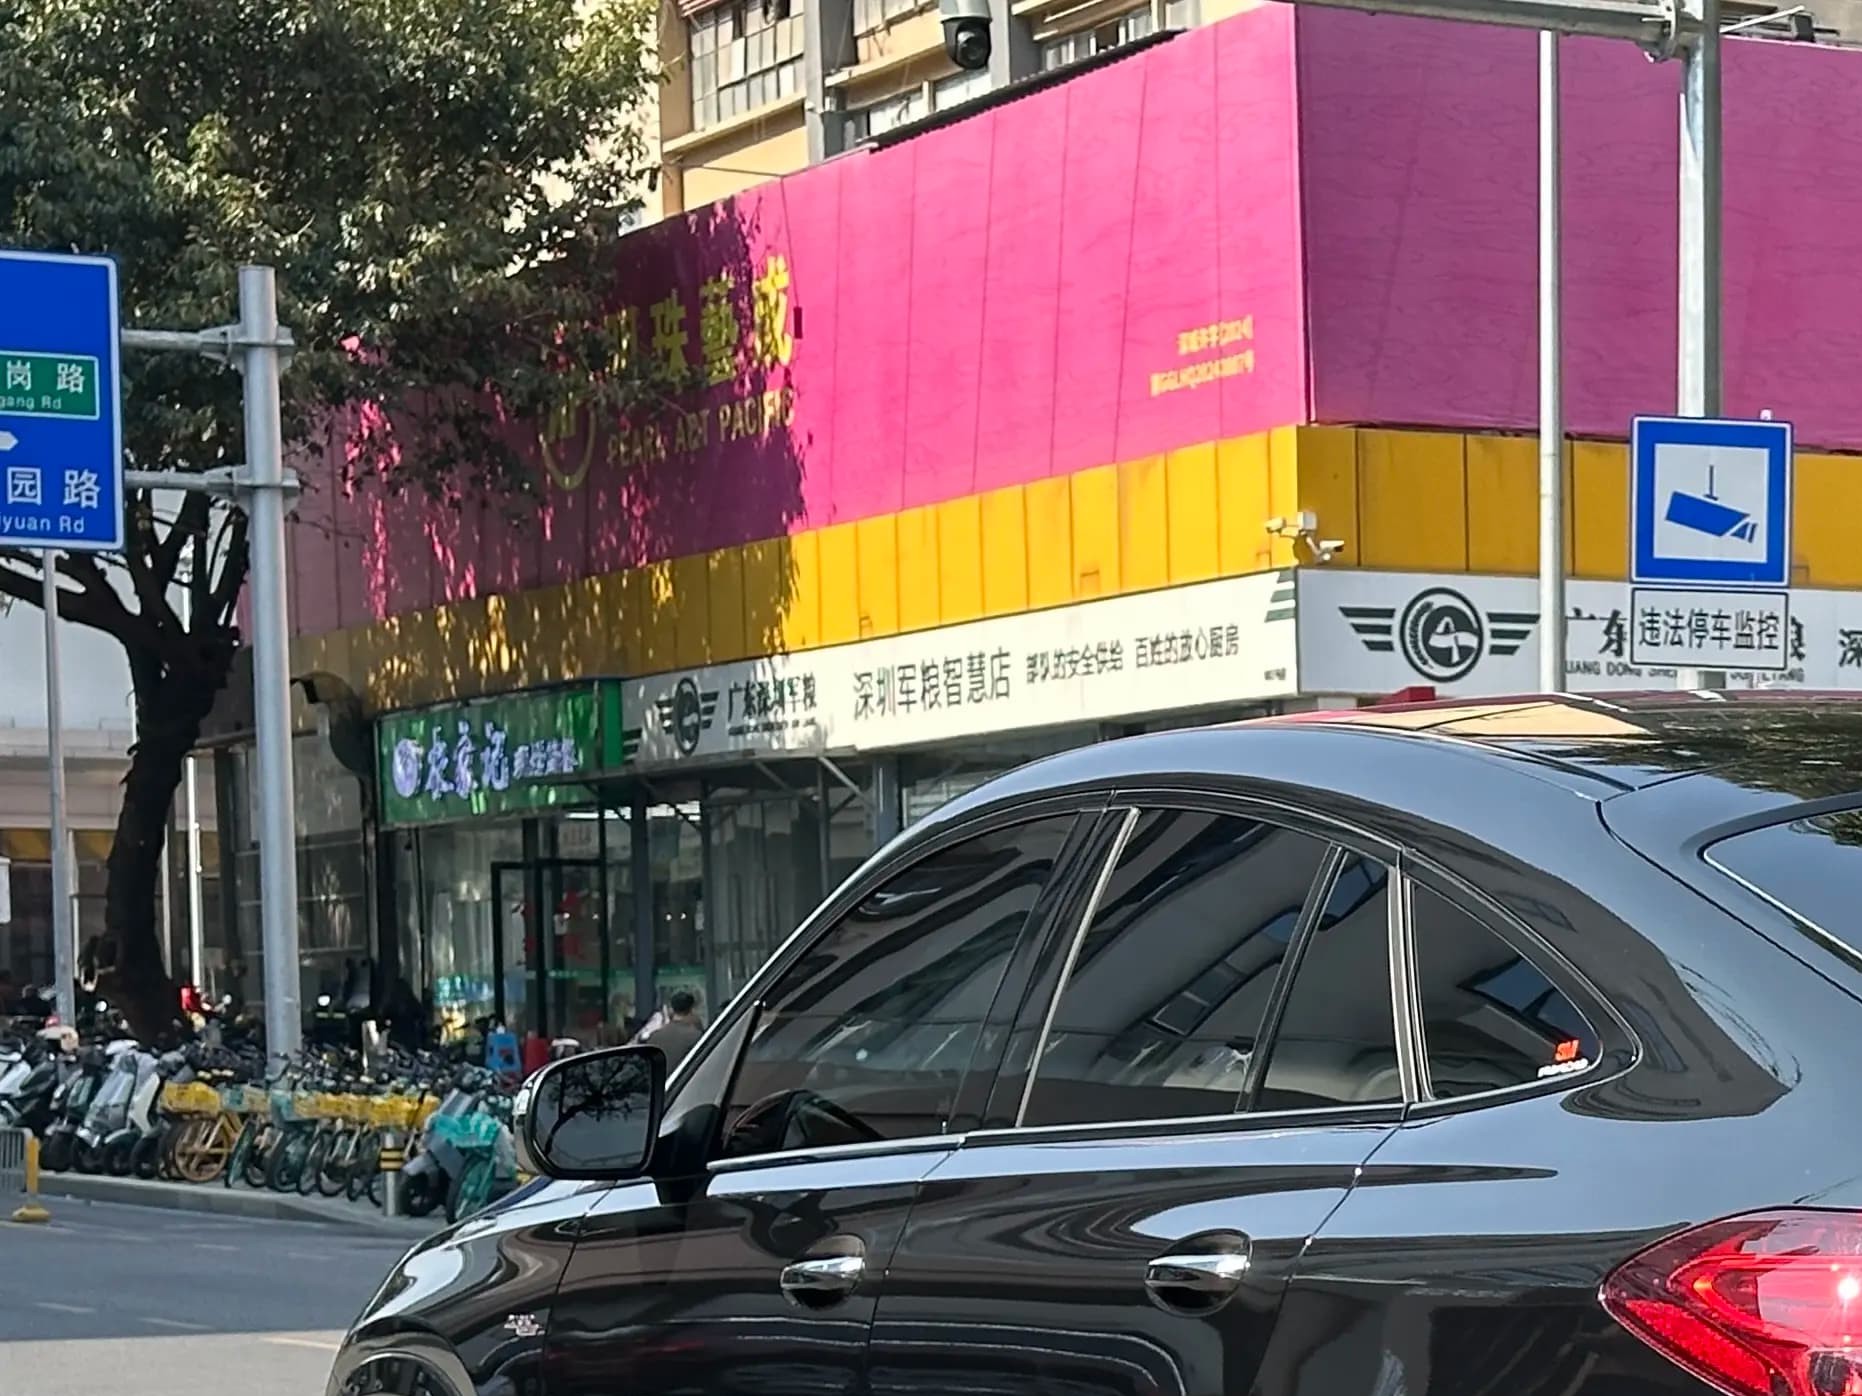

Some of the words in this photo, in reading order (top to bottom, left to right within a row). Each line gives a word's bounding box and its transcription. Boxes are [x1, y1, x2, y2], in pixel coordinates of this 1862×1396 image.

[41, 395, 62, 410] Rd
[718, 385, 796, 442] PACIFIC
[59, 515, 84, 533] Rd
[1135, 623, 1240, 669] 百姓的放心厨房
[1638, 606, 1780, 650] 违法停车监控
[852, 646, 1011, 721] 深圳军粮智慧店
